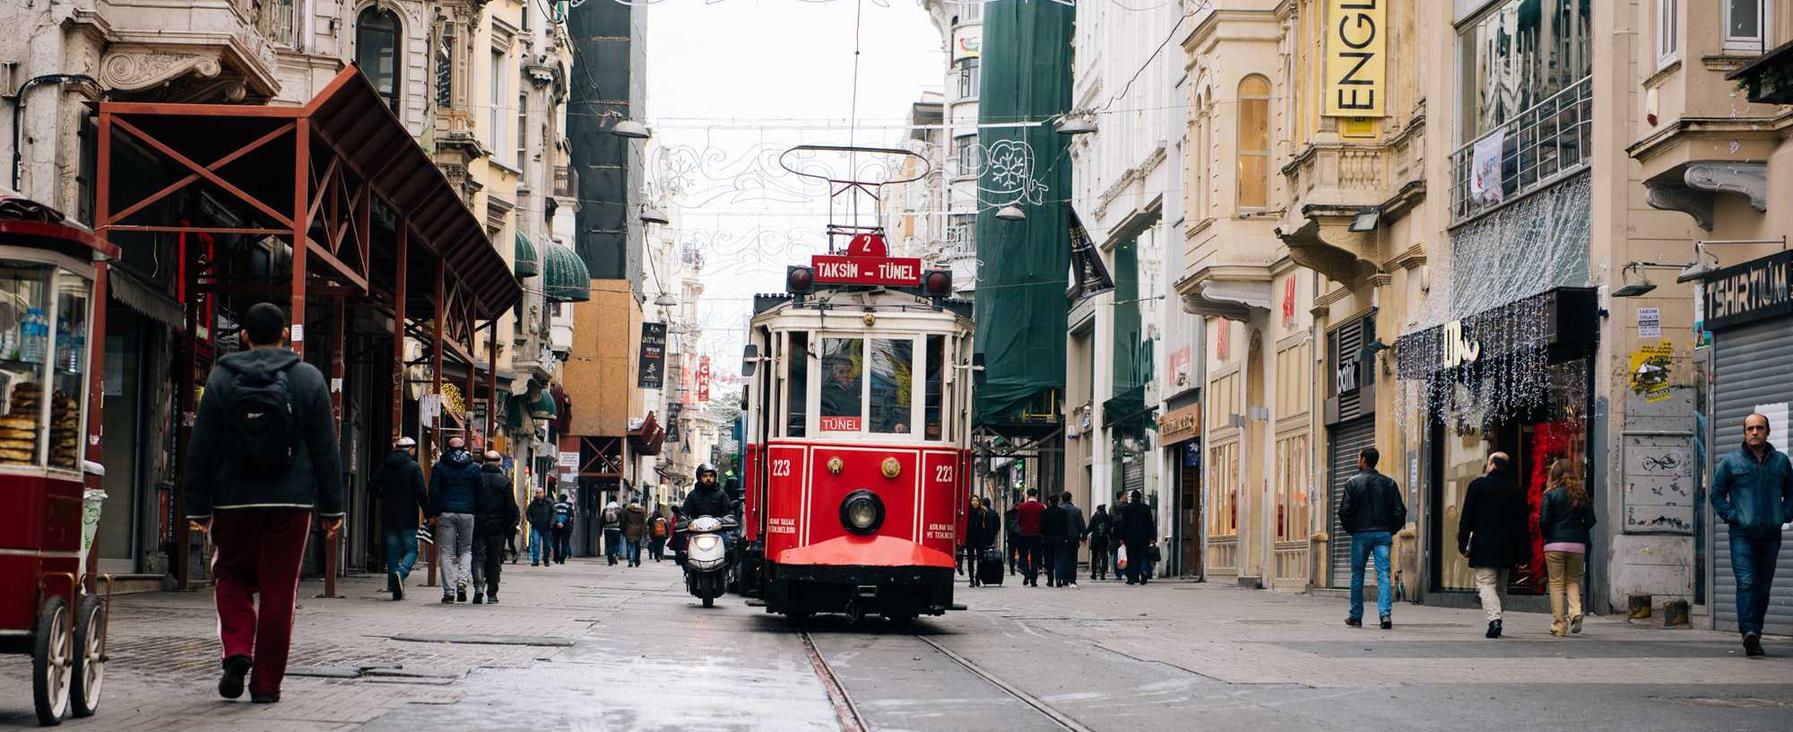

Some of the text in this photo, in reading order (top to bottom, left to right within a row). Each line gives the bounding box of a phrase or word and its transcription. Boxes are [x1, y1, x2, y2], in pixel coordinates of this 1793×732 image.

[1338, 0, 1376, 109] ENGL
[862, 235, 872, 252] 2
[817, 260, 858, 278] TAKSİM
[878, 262, 917, 280] TÜNEL
[823, 417, 859, 430] TÜNEL
[772, 459, 791, 477] 223
[935, 465, 953, 483] 223
